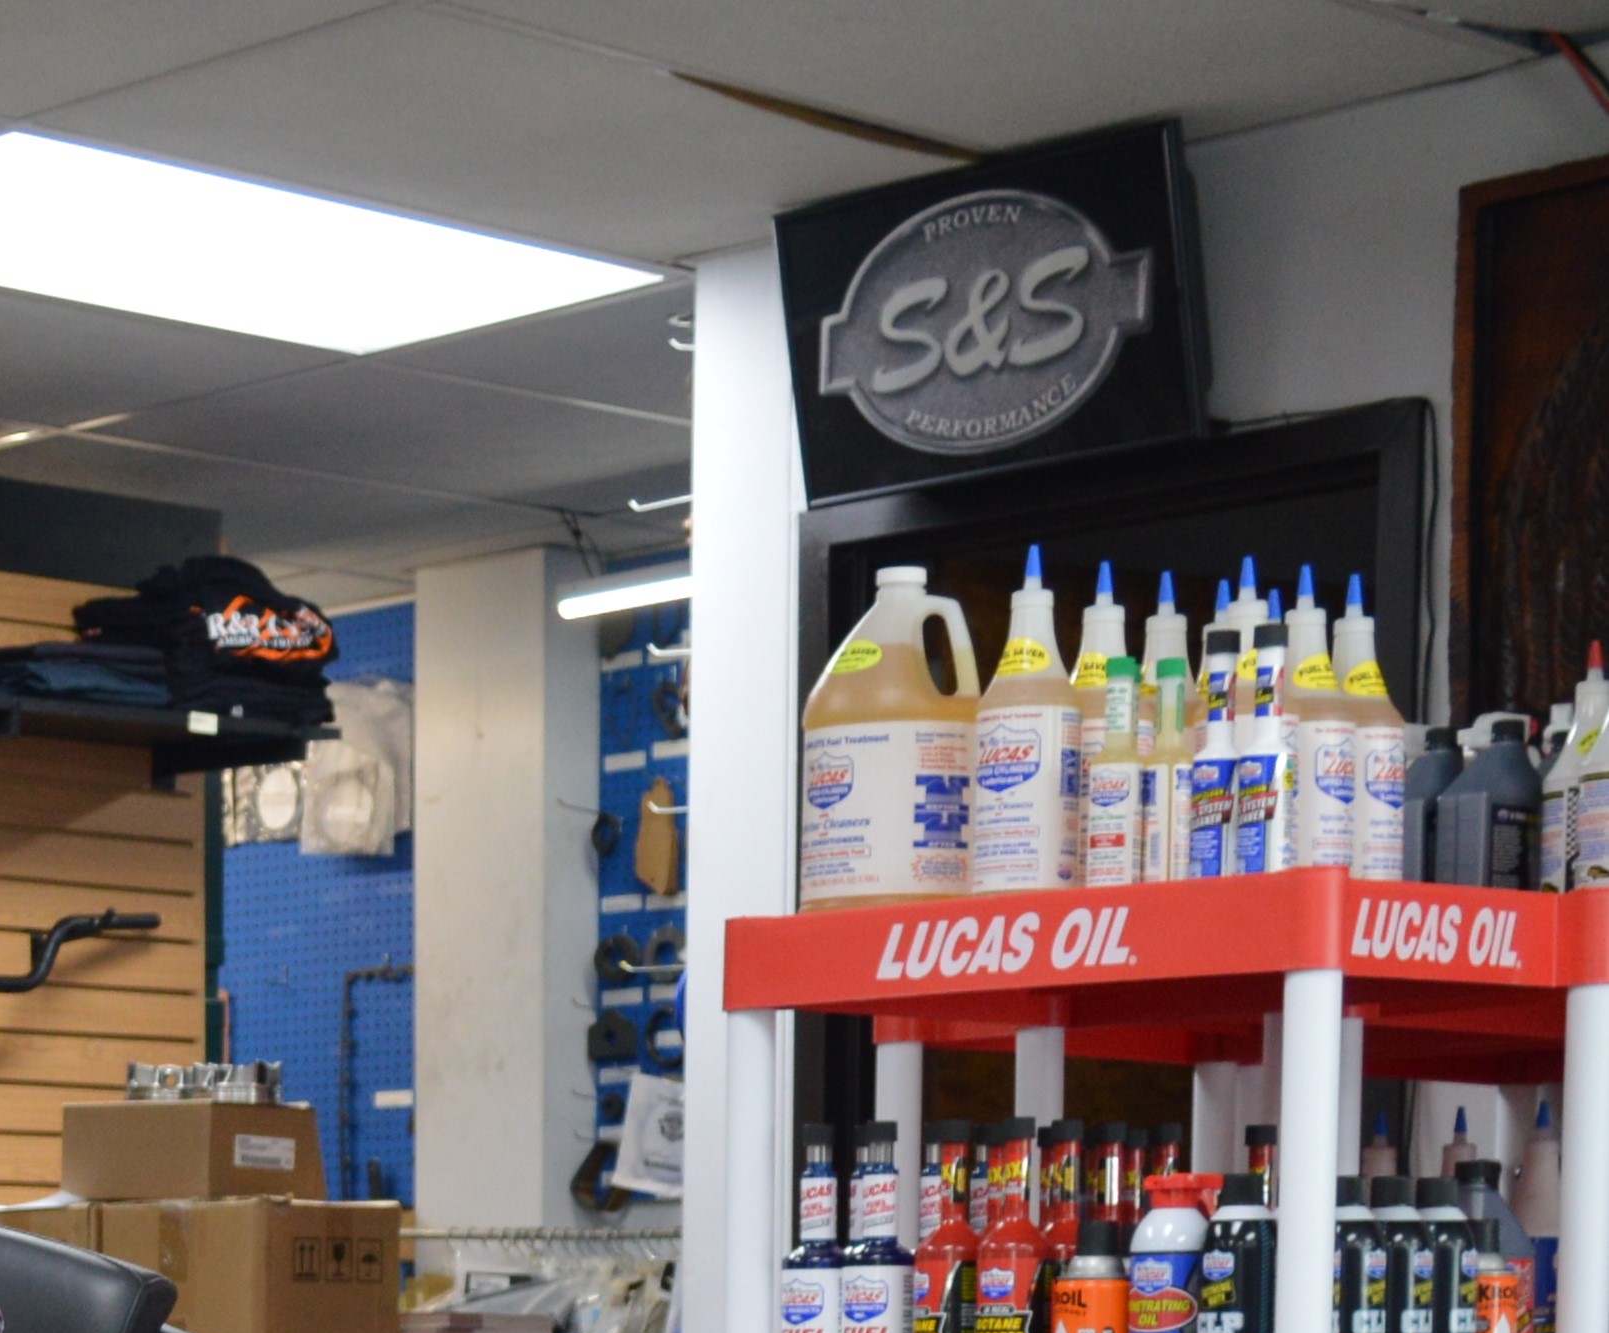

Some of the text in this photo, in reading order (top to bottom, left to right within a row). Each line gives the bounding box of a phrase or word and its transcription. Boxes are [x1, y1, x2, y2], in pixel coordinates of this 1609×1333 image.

[924, 203, 1023, 242] PROVEN
[872, 245, 1090, 394] S&S
[905, 372, 1076, 438] PERFORMANCE
[877, 906, 1130, 981] LUCAS OIL
[1351, 898, 1521, 968] LUCAS OIL
[976, 1317, 1023, 1332] OCTANE
